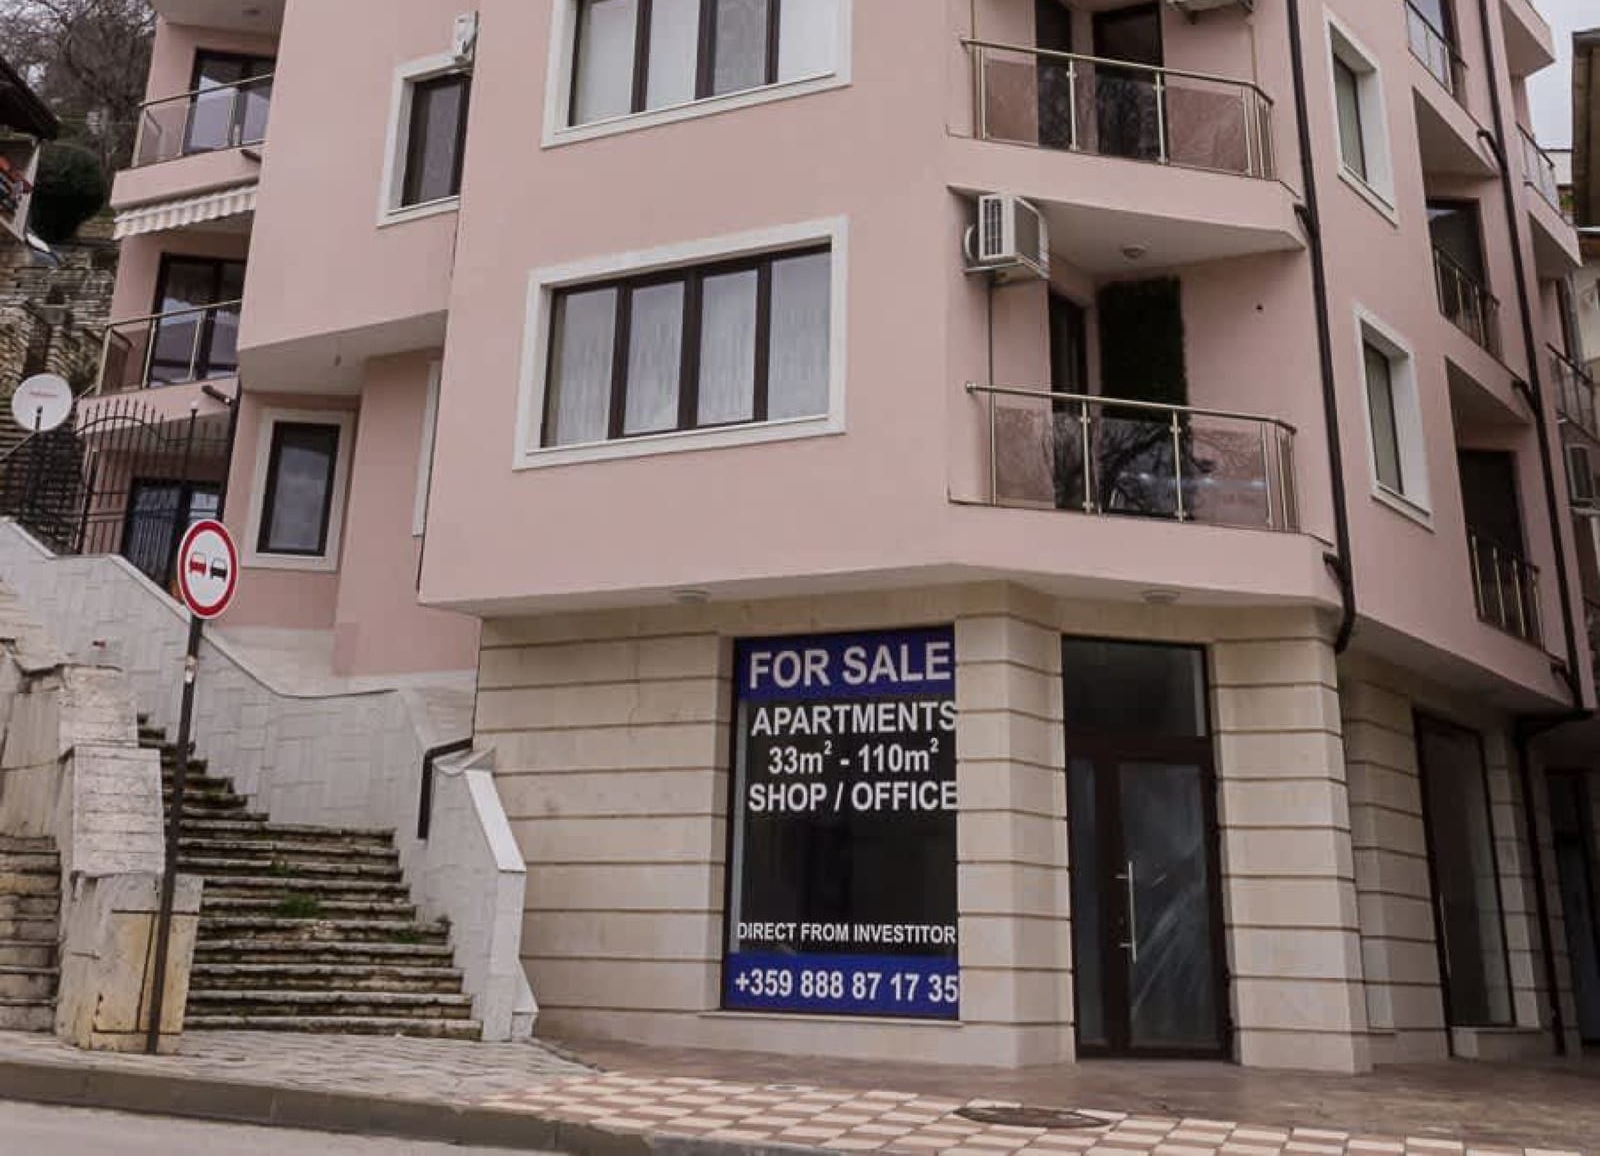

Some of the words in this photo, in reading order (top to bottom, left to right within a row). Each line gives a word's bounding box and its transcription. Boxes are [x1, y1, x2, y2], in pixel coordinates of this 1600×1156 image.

[750, 648, 831, 689] FOR
[842, 642, 951, 684] SALE
[751, 700, 958, 736] APARTMENTS
[748, 783, 827, 812] SHOP
[851, 781, 958, 811] OFFICE
[737, 922, 797, 941] DIRECT
[801, 923, 849, 942] FROM
[854, 924, 955, 944] INVESTITOR
[735, 968, 793, 996] +359
[801, 970, 844, 999] 888
[852, 972, 882, 1000] 87
[890, 973, 920, 1001] 17
[928, 974, 958, 1003] 35
